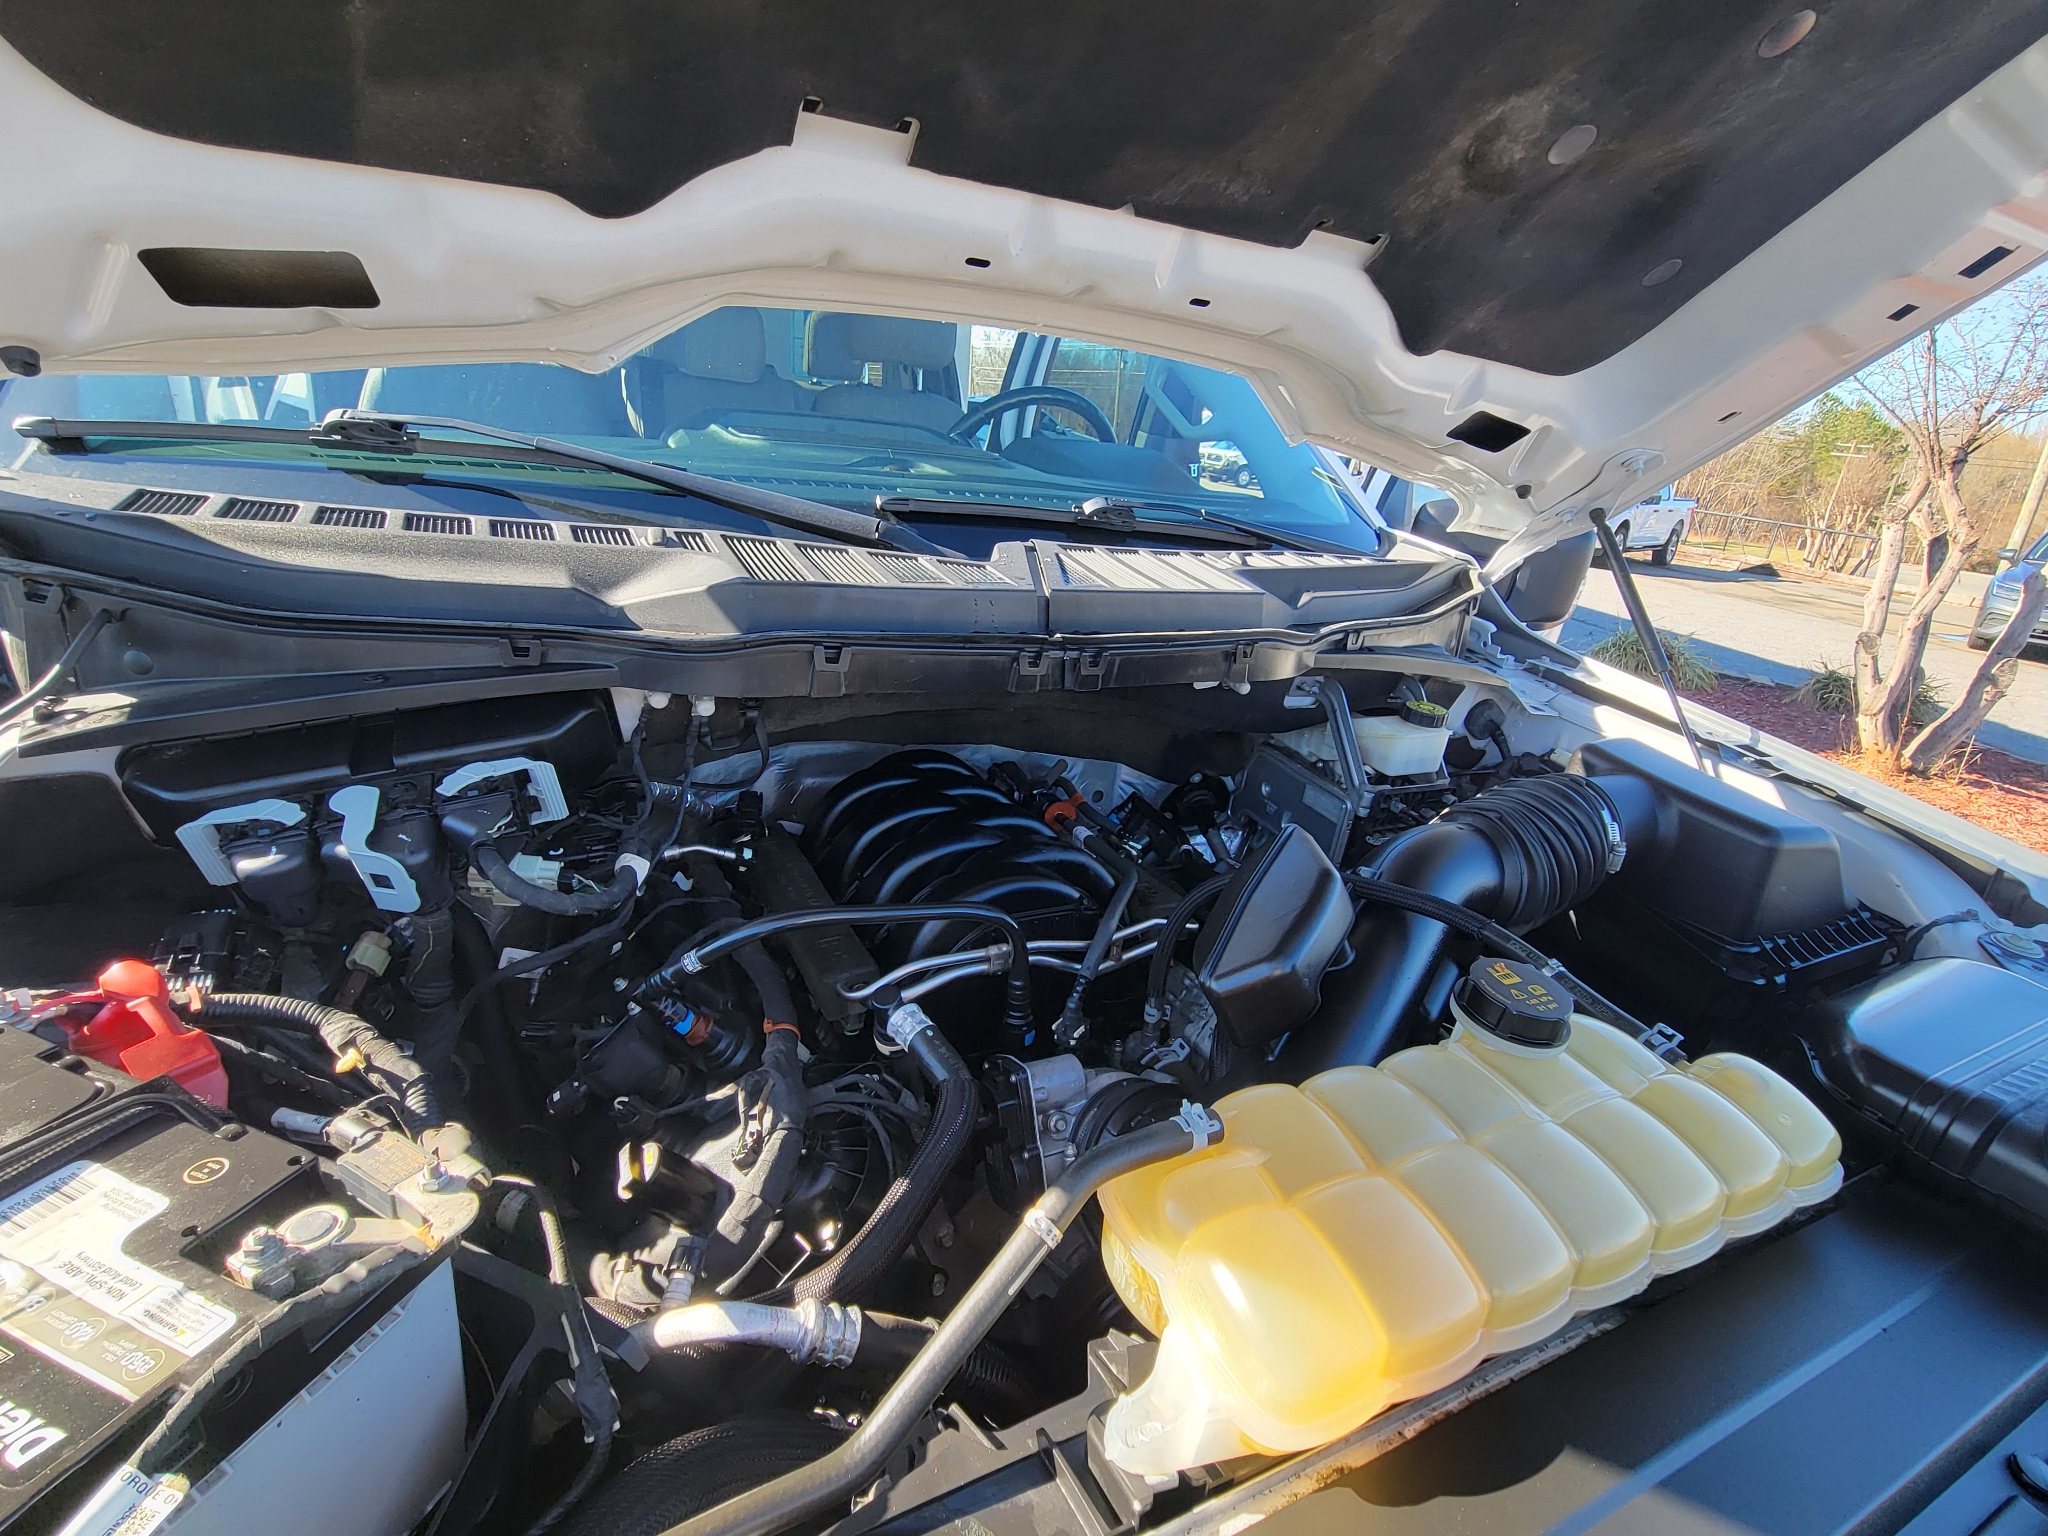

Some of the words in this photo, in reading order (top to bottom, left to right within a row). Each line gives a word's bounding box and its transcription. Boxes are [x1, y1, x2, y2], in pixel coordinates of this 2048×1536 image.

[99, 1266, 121, 1282] Acid
[119, 1274, 143, 1292] Lead
[64, 1321, 97, 1342] 140
[120, 1351, 156, 1375] 850
[0, 1395, 70, 1470] Die
